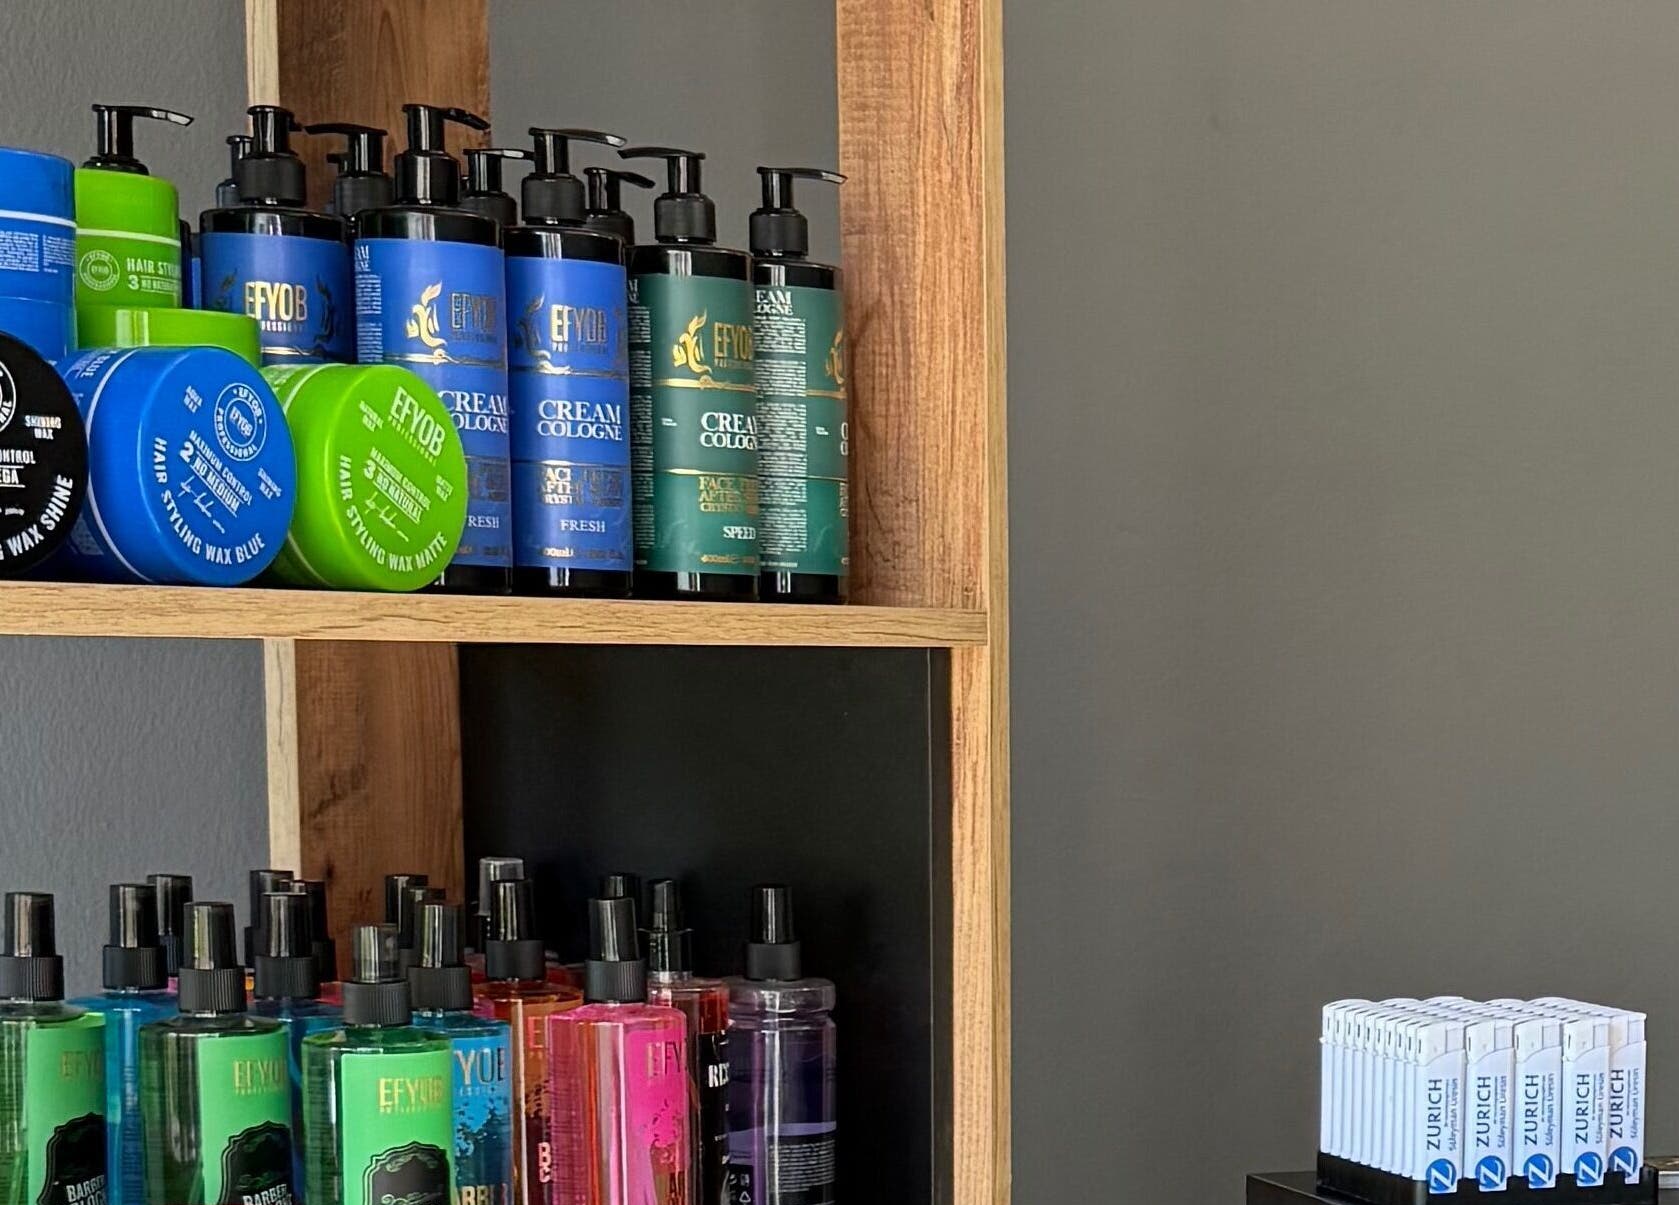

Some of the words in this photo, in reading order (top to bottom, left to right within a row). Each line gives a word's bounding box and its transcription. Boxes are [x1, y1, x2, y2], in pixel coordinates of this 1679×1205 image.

[126, 257, 155, 273] HAIR
[128, 276, 139, 289] 3
[245, 281, 308, 321] EFYOB
[755, 289, 792, 305] EAM
[551, 303, 608, 344] EFYOB
[390, 386, 446, 457] EFYOB
[450, 413, 508, 433] OLOGN
[537, 419, 623, 442] COLOGNE
[538, 398, 622, 425] CREAM
[0, 449, 36, 464] ONTROL
[180, 441, 194, 463] 2
[363, 460, 377, 480] 3
[0, 469, 19, 484] EGA
[340, 454, 353, 501] HAIR
[7, 524, 44, 557] WAX
[40, 474, 73, 531] SHINE
[153, 437, 168, 484] HAIR
[161, 489, 202, 555] STYLING
[205, 543, 233, 565] WAX
[236, 532, 266, 564] BLUE
[346, 505, 386, 565] STYLING
[467, 515, 499, 528] RESH
[560, 519, 605, 533] FRESH
[388, 552, 414, 572] WAX
[415, 531, 448, 569] MATTE
[454, 1047, 506, 1086] YOB
[1427, 1078, 1443, 1151] ZURICH
[1476, 1076, 1491, 1148] ZURICH
[1524, 1074, 1540, 1146] ZURICH
[1575, 1073, 1590, 1145] ZURICH
[1609, 1069, 1625, 1139] ZURICH
